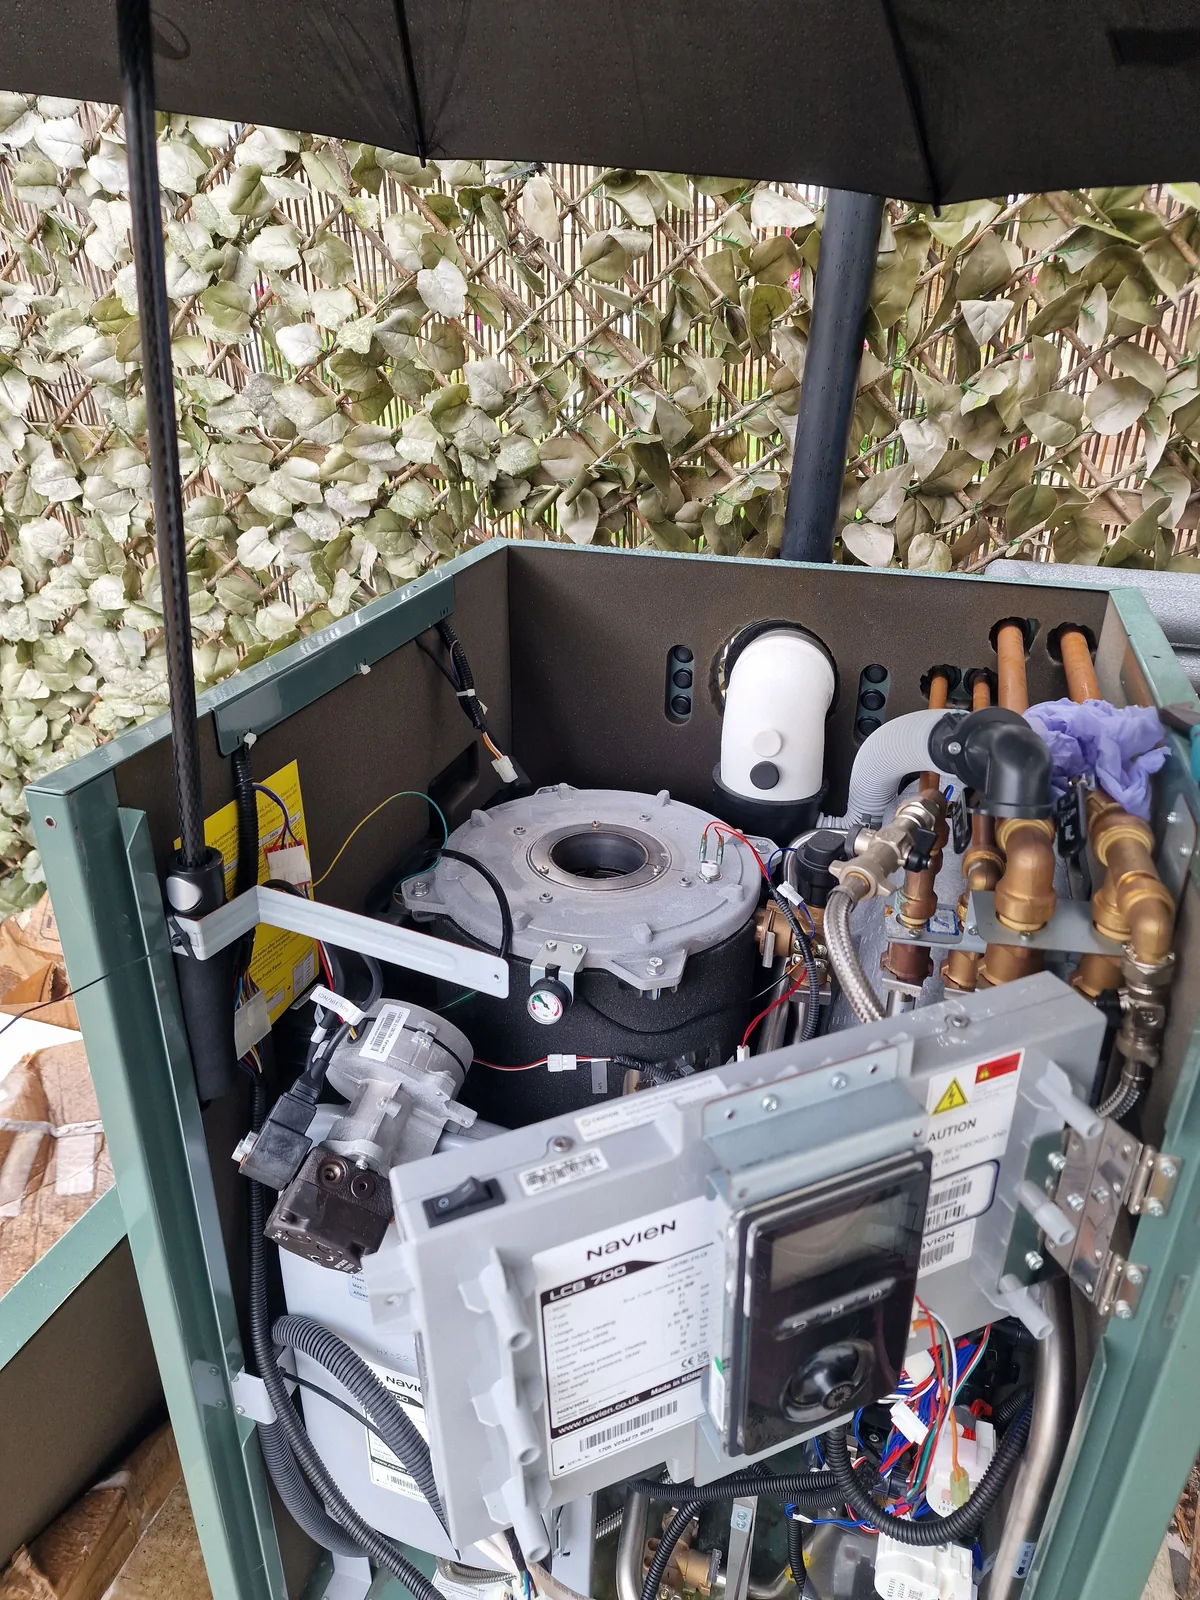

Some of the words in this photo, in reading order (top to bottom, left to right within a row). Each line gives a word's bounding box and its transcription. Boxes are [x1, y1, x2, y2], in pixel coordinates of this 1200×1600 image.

[928, 1117, 977, 1143] AUTION
[550, 1280, 585, 1301] LCB
[591, 1265, 627, 1286] 700
[558, 1396, 640, 1434] www.navien.co.uk
[650, 1384, 672, 1396] Made
[672, 1380, 681, 1388] in
